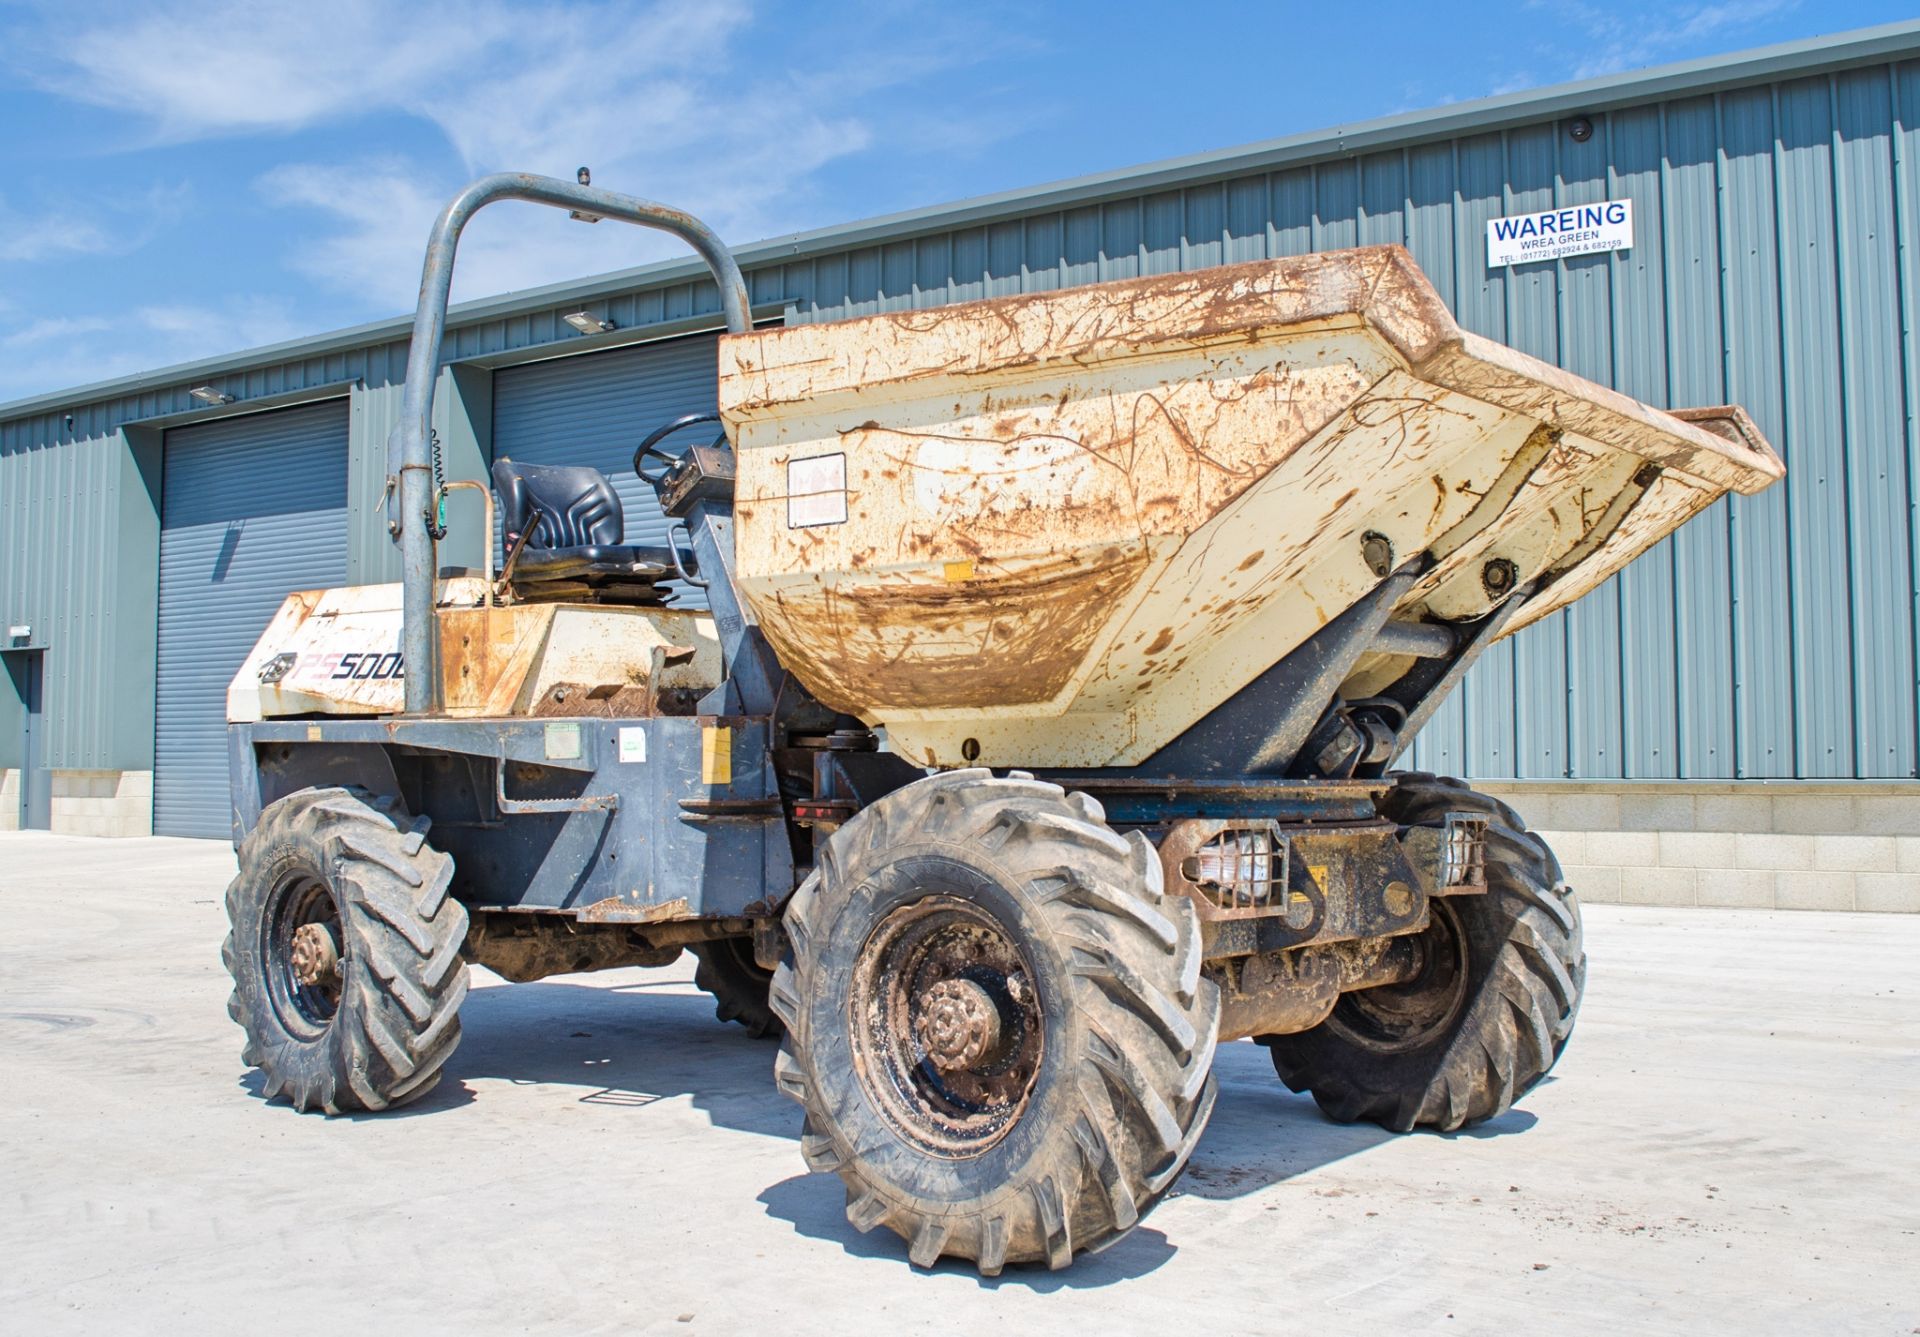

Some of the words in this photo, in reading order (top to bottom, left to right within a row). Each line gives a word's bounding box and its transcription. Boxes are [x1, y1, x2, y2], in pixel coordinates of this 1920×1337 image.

[1495, 203, 1626, 241] WAREING
[1499, 254, 1519, 263] TEL:
[1520, 250, 1551, 261] (01772)
[1583, 243, 1590, 251] &
[1591, 239, 1622, 250] 682159
[1520, 237, 1555, 250] WREA
[1558, 230, 1600, 245] GREEN
